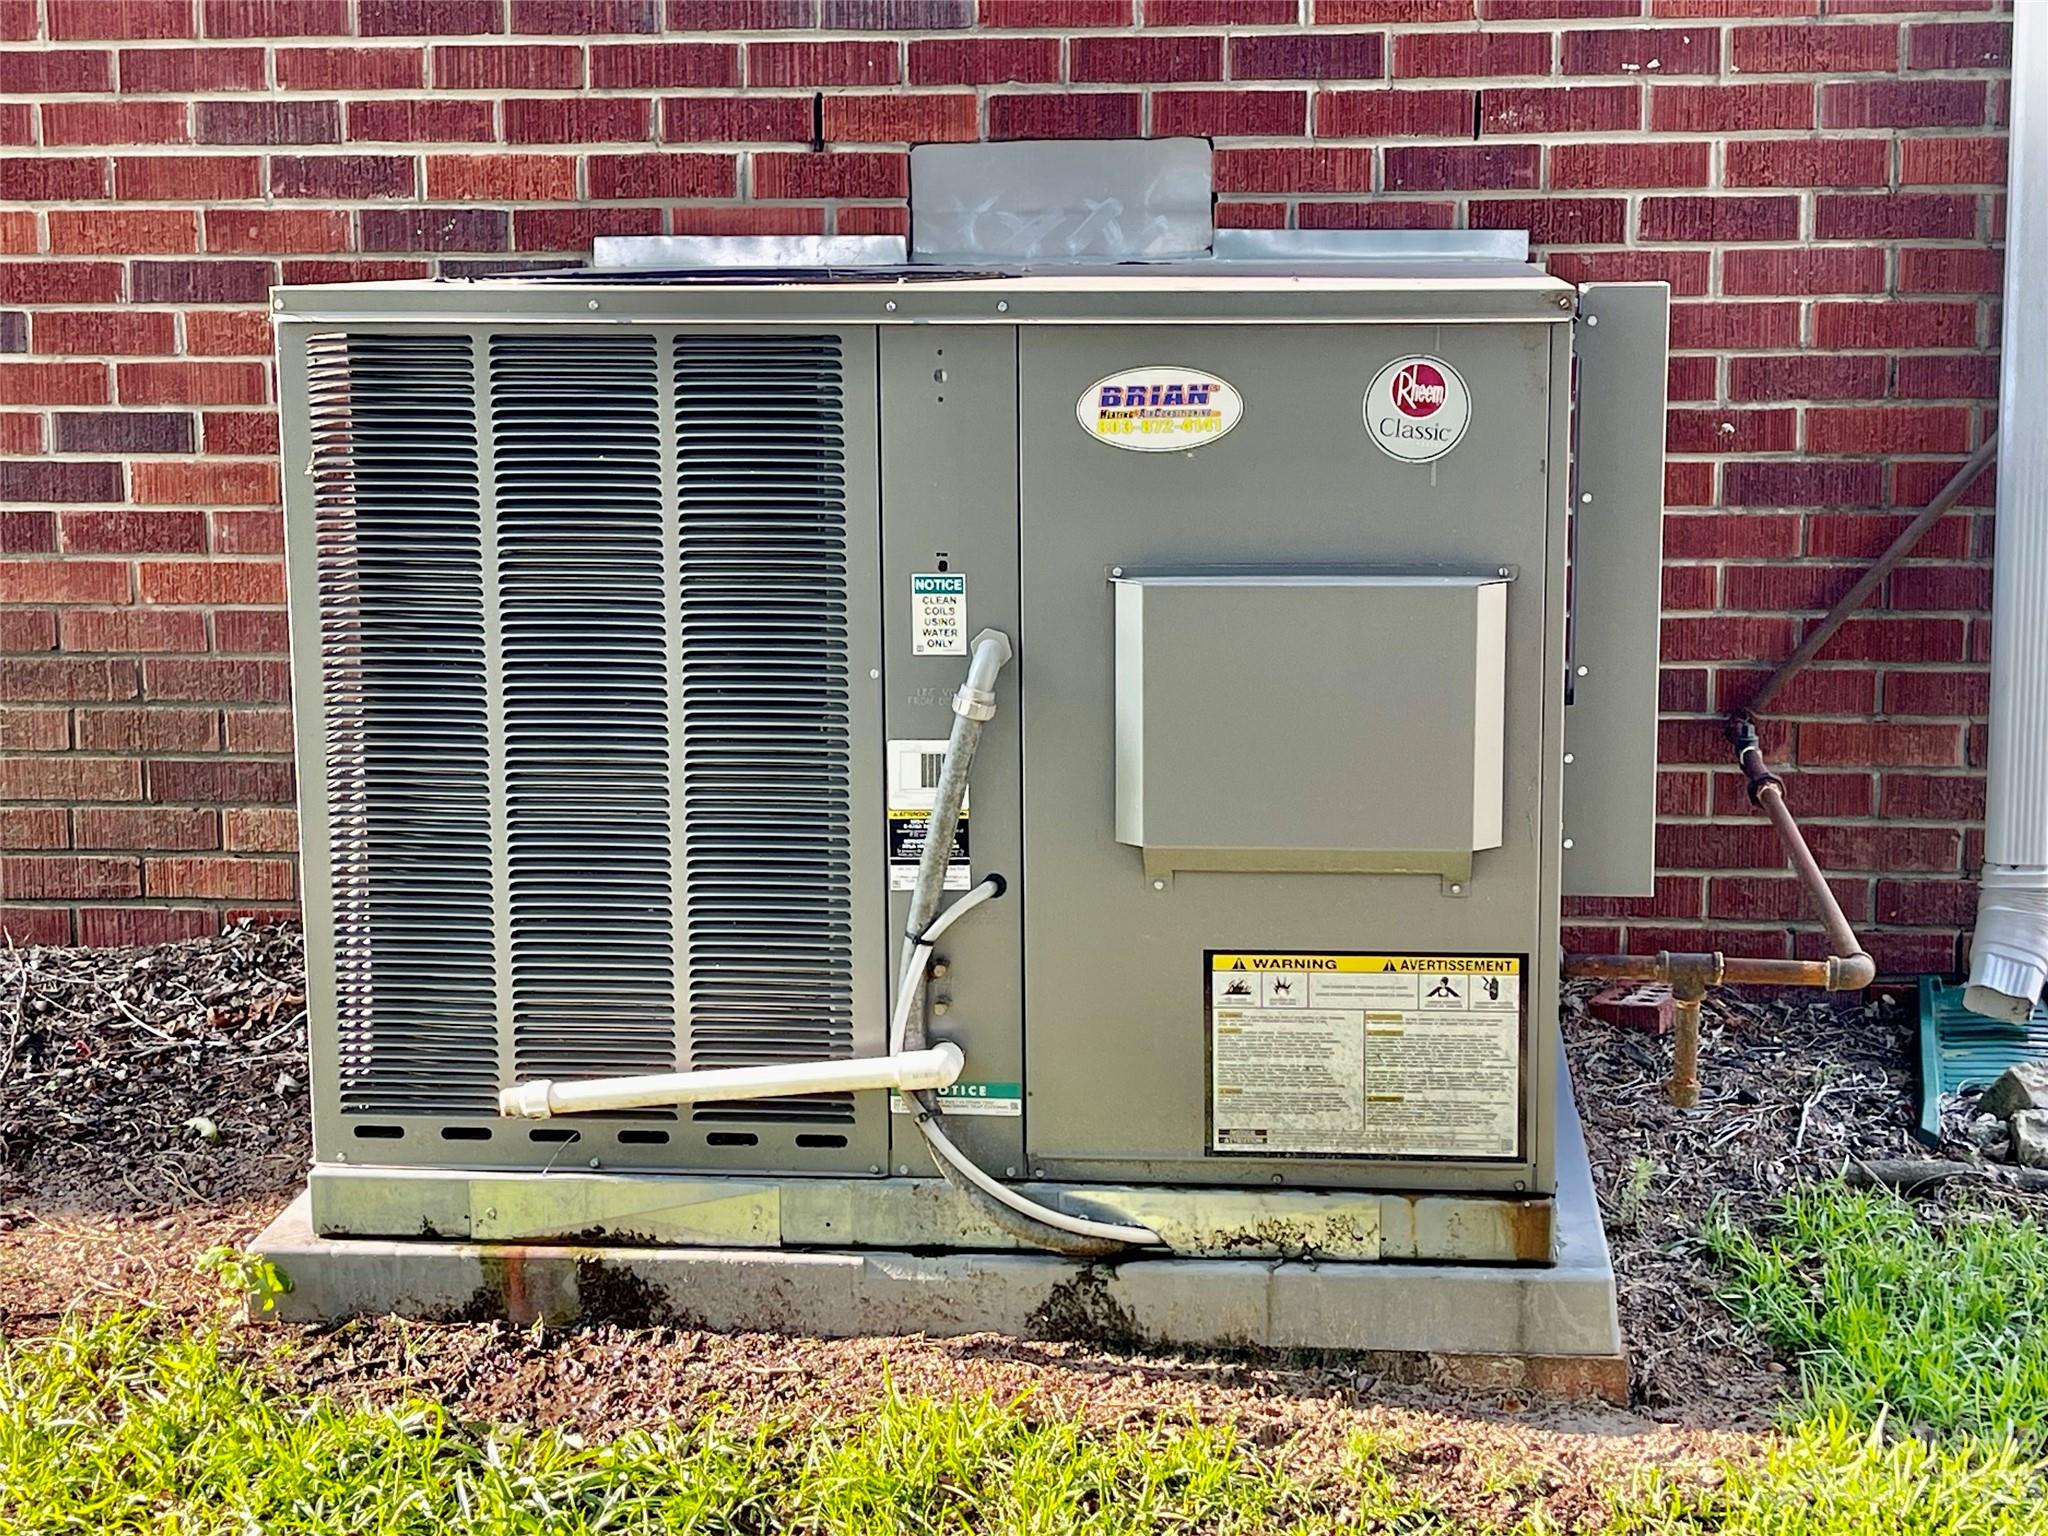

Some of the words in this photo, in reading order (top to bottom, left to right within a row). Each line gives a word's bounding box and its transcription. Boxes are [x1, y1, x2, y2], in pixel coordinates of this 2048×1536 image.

[1396, 364, 1445, 410] Rheem
[1379, 417, 1453, 442] Classic
[915, 578, 963, 591] NOTICE
[922, 596, 957, 605] CLEAN
[924, 607, 956, 616] COILS
[924, 618, 956, 627] USING
[922, 629, 959, 638] WATER
[926, 639, 954, 648] ONLY
[1253, 958, 1338, 970] WARNING
[1400, 959, 1513, 972] AVERTISSEMENT
[937, 1084, 988, 1097] OTICE
